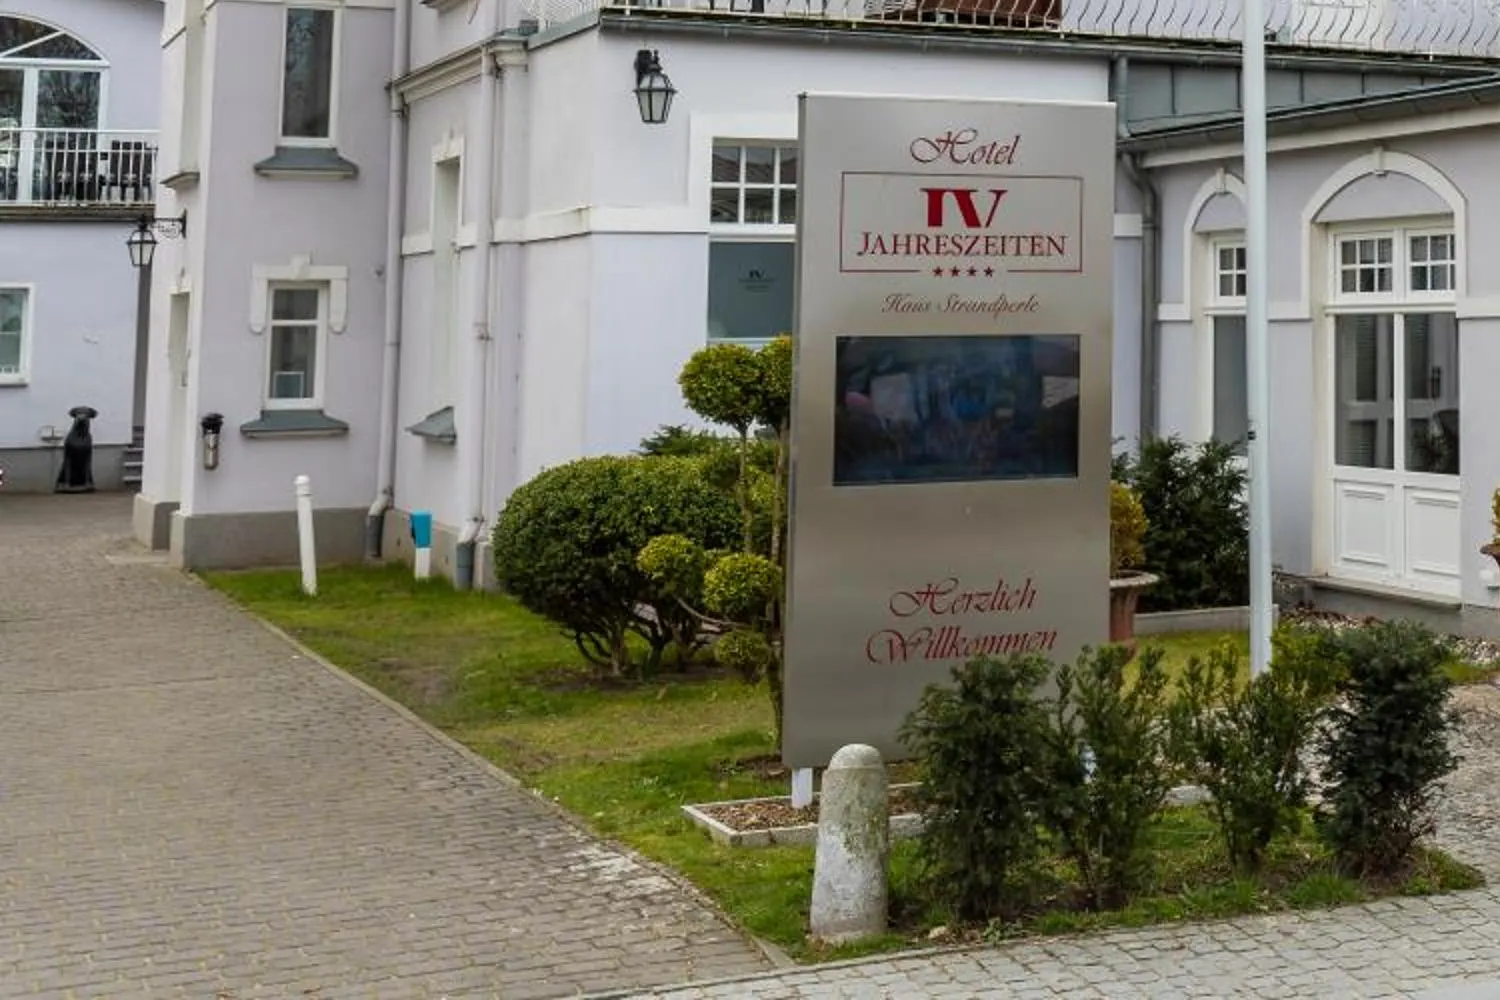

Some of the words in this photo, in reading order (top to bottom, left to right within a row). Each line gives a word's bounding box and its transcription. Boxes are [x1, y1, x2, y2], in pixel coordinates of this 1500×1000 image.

[909, 127, 1021, 166] Hotel
[919, 187, 1009, 229] IV
[855, 231, 1069, 257] JAHRESZEITEN
[881, 293, 930, 314] Haus
[938, 293, 1041, 321] Strandperle
[888, 577, 1037, 618] Herzlich
[865, 624, 1058, 665] Willkommen
